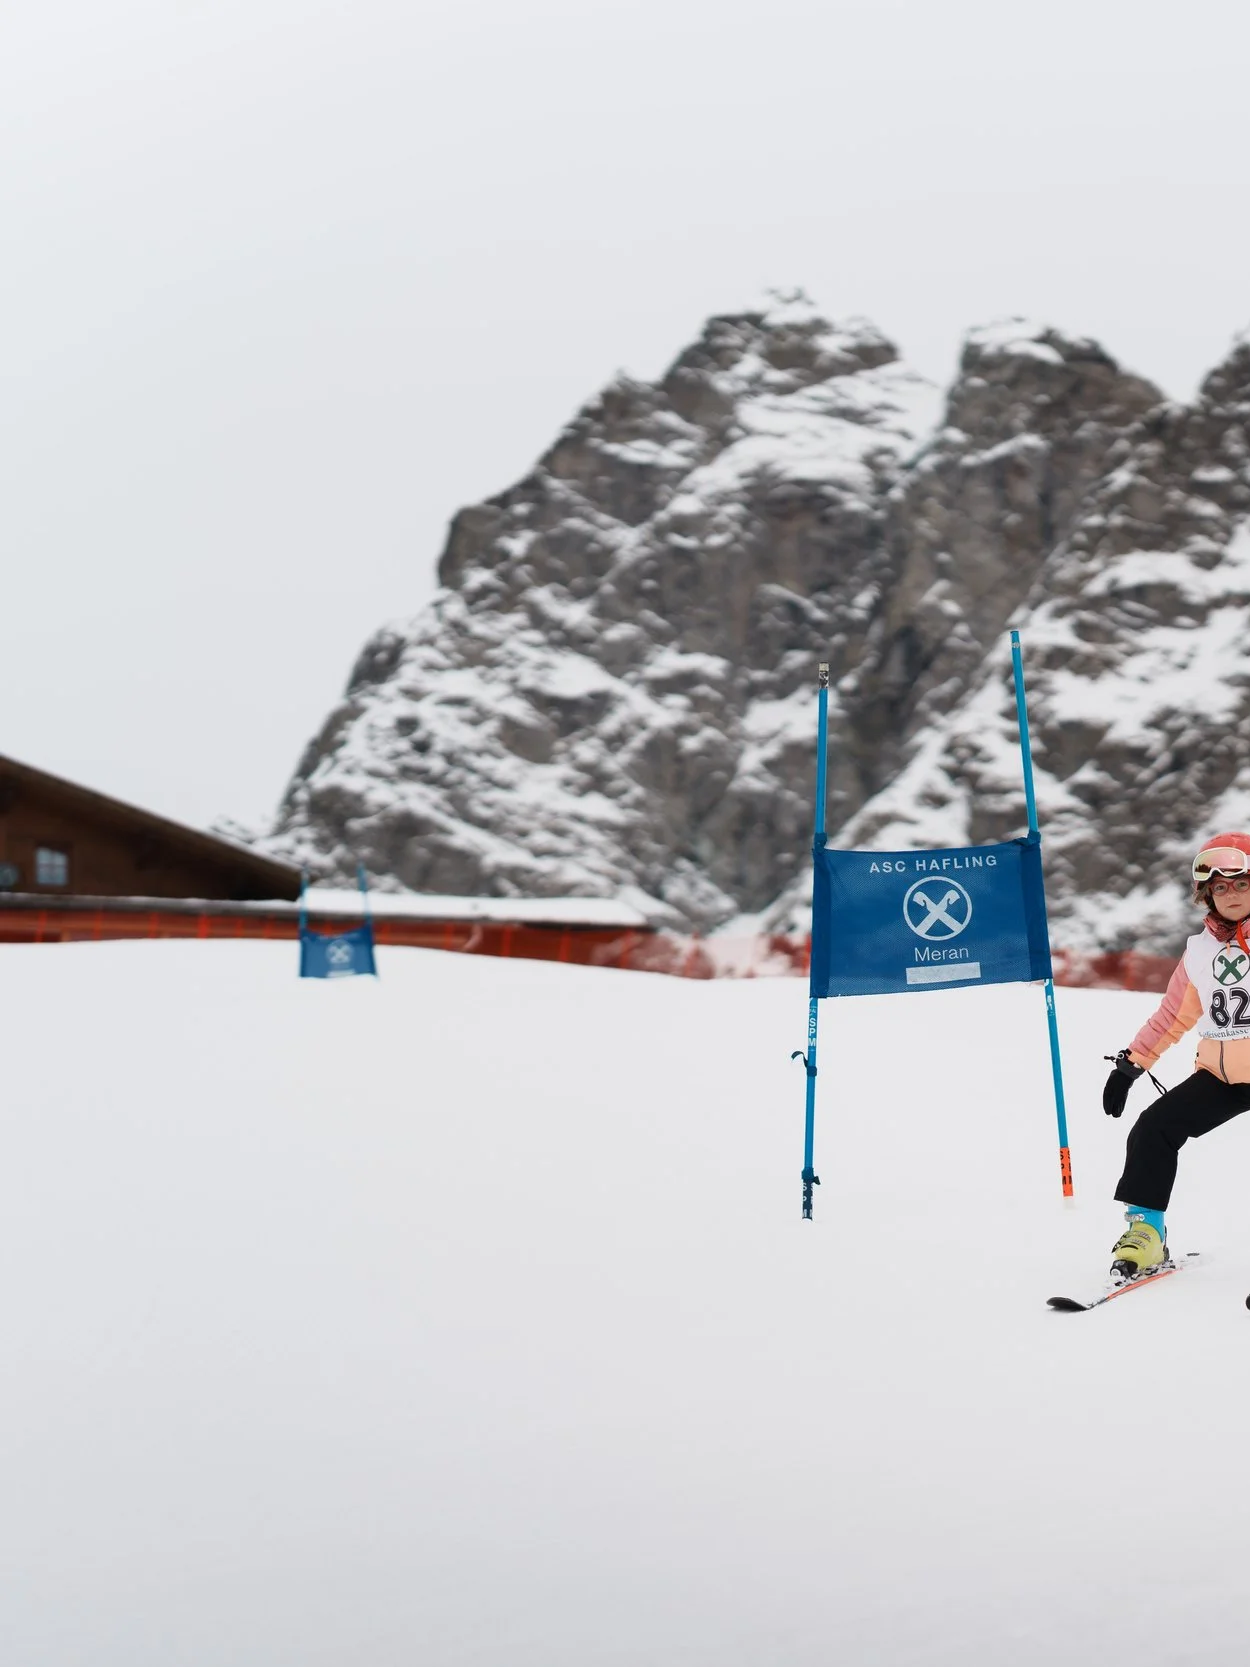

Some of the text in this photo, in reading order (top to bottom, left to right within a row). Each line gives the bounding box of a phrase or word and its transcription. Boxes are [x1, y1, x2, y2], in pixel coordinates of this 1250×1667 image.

[869, 855, 997, 873] ASC HAFLING
[914, 946, 969, 962] Meran
